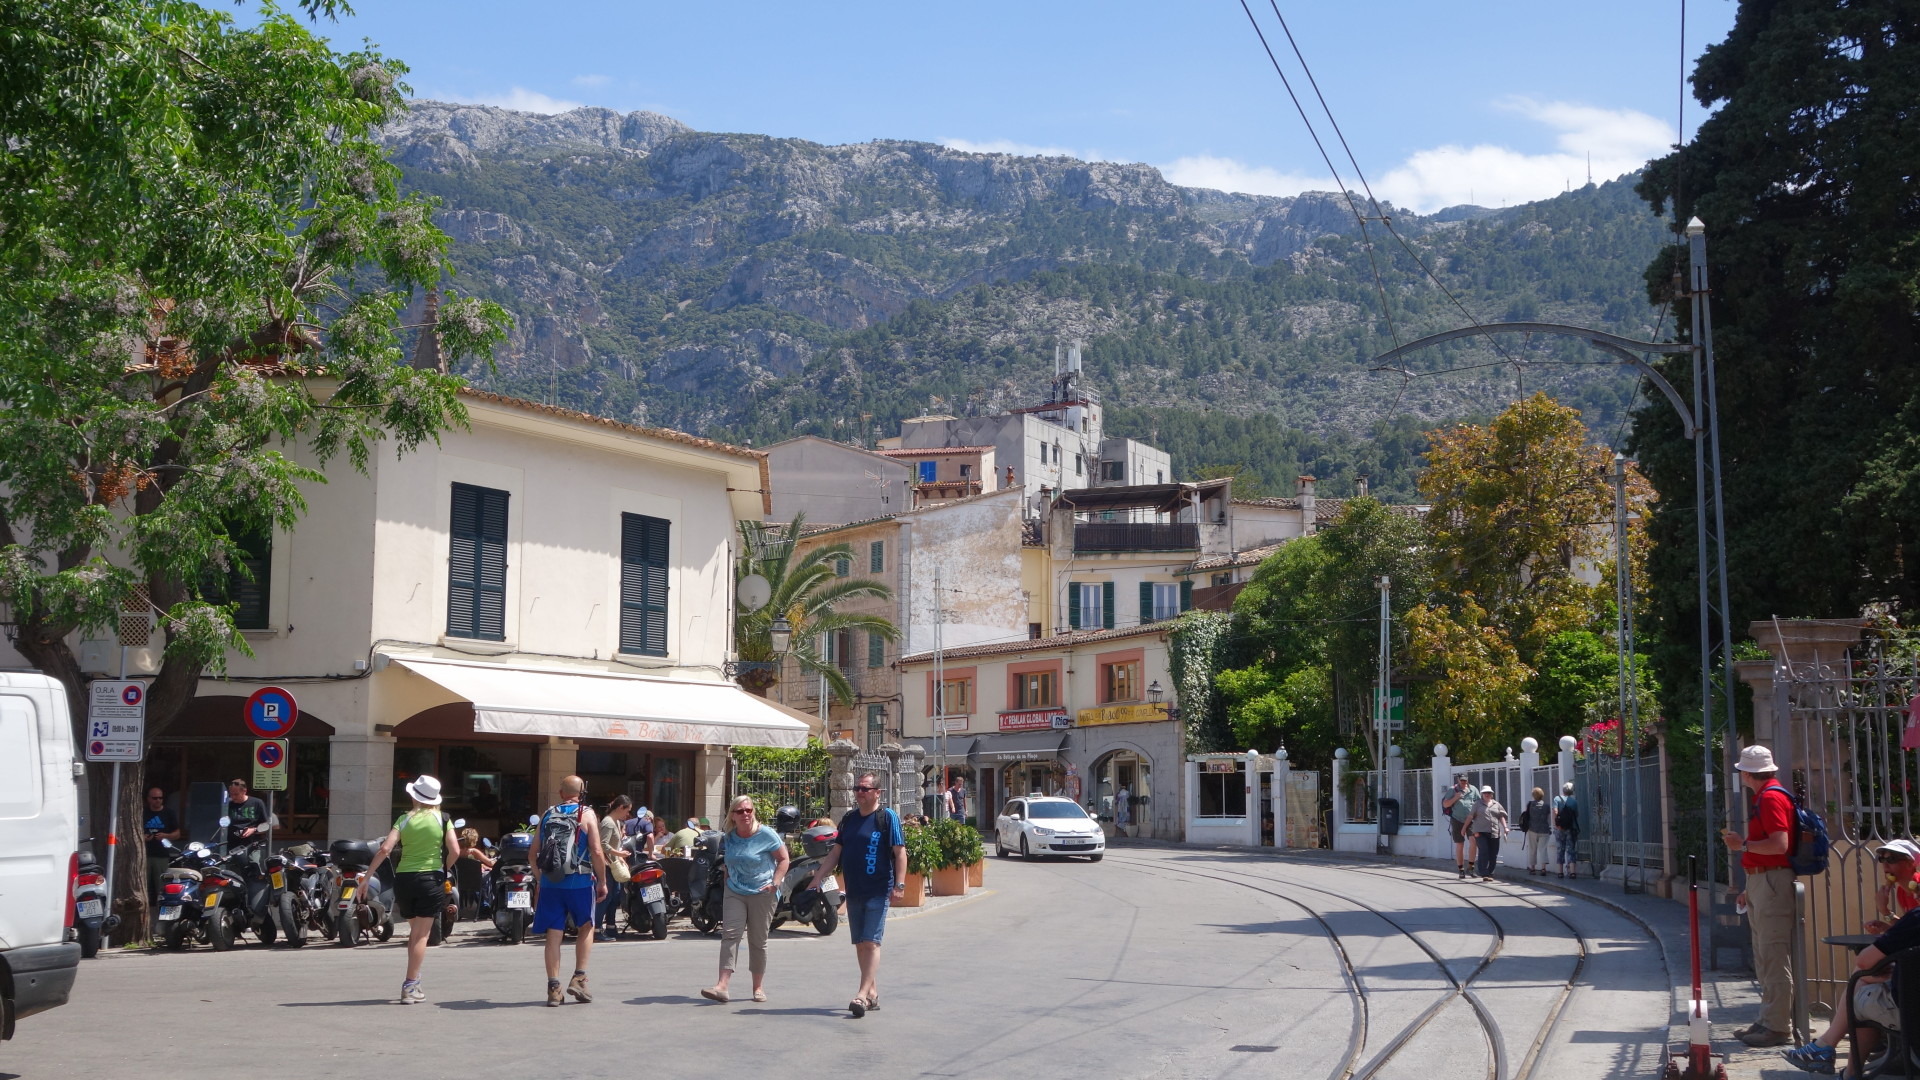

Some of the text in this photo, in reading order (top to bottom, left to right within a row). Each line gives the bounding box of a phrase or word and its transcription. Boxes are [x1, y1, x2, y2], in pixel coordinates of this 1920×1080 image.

[267, 705, 276, 716] P
[639, 722, 659, 738] Bar
[683, 725, 703, 741] Via
[866, 831, 881, 875] adidas
